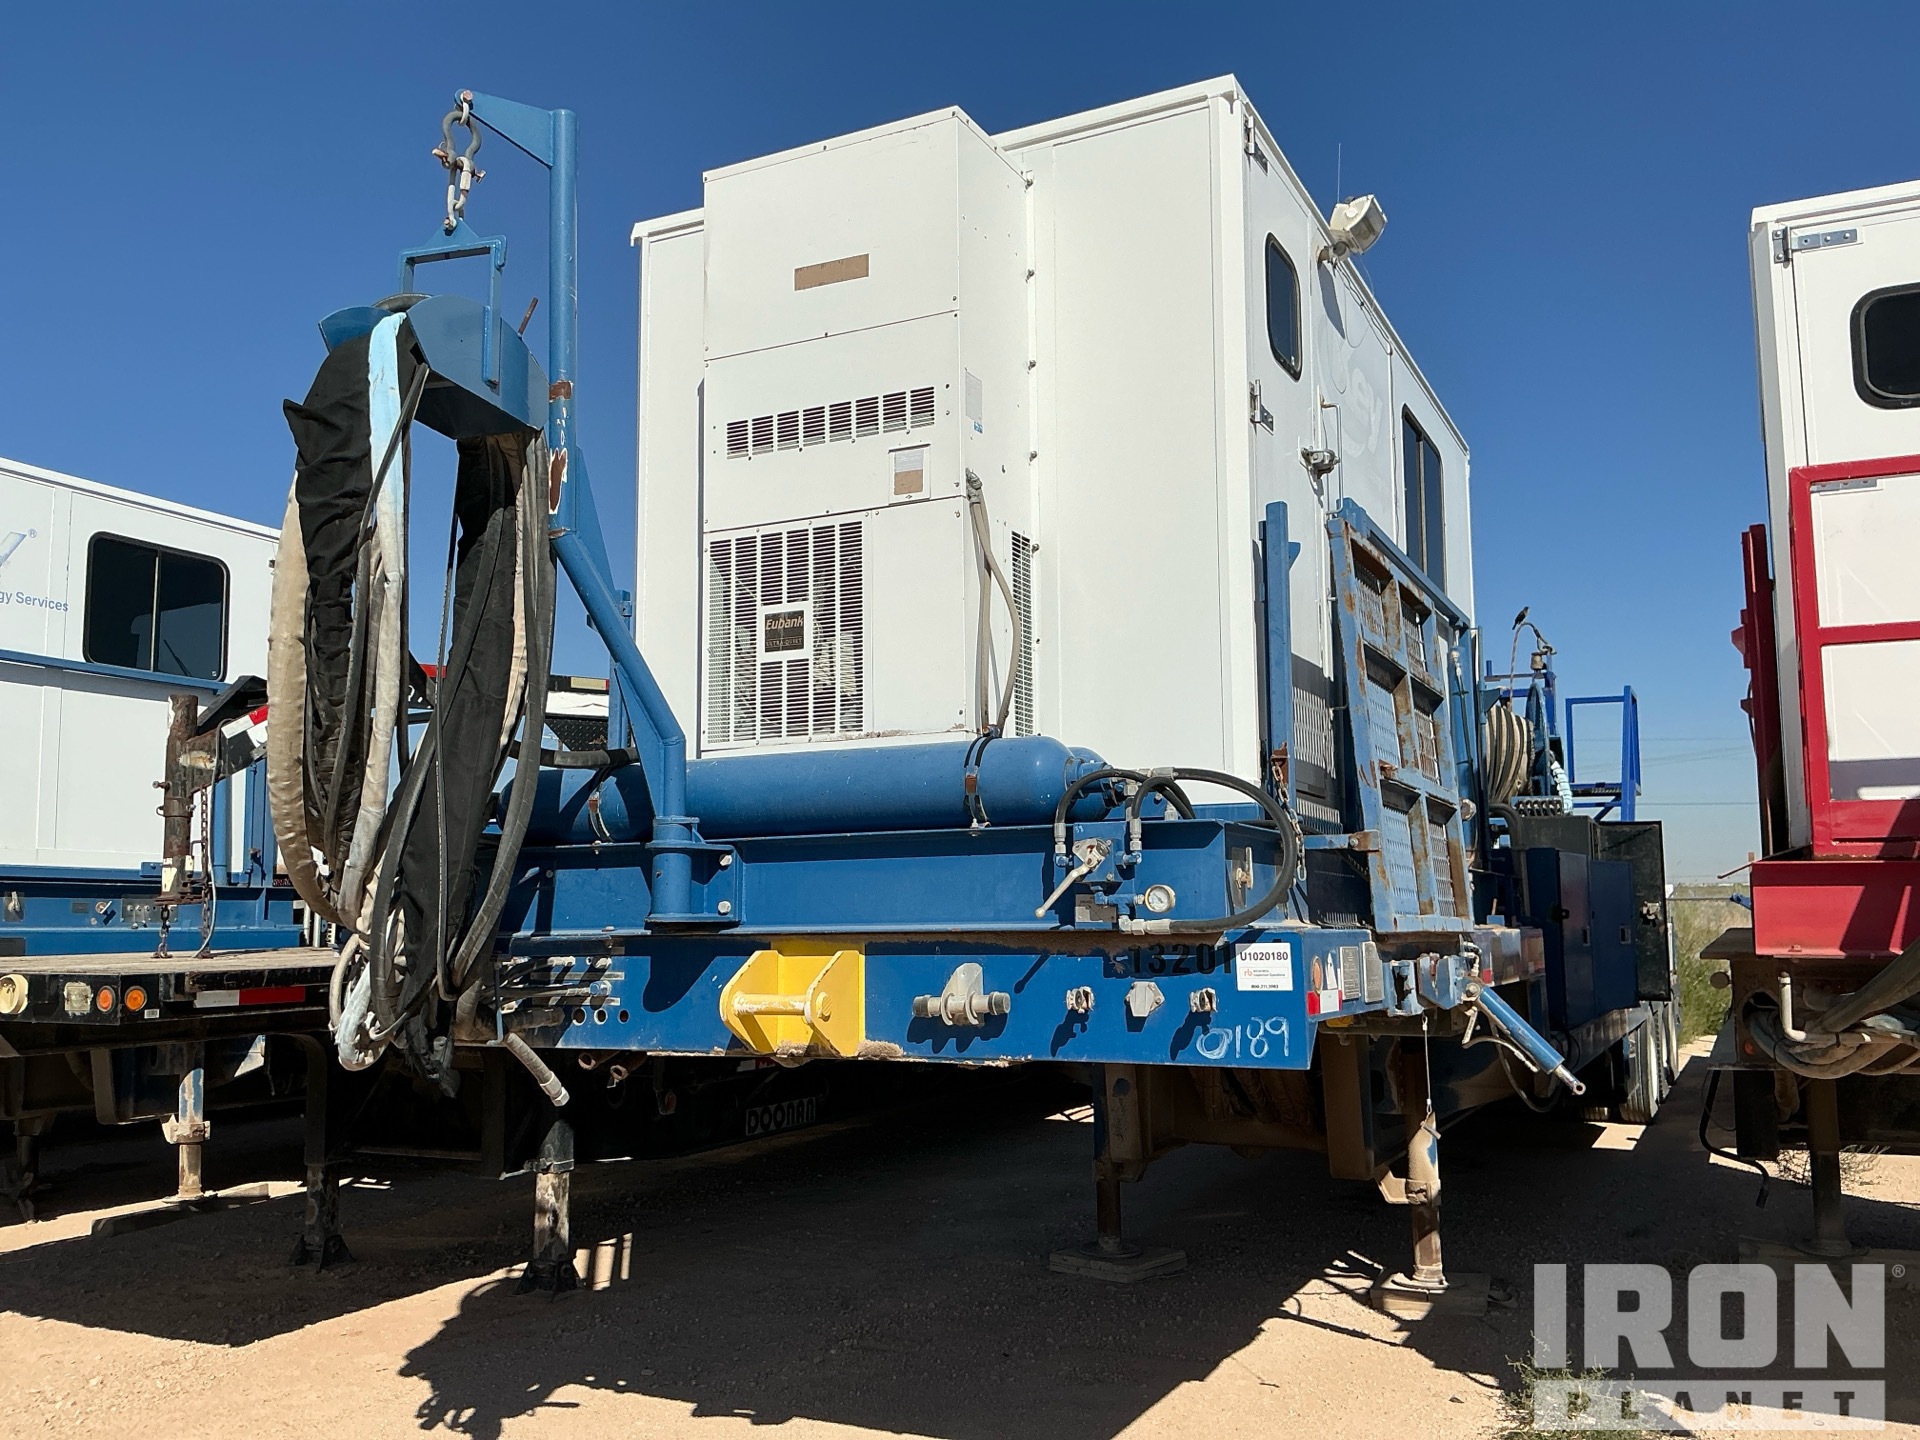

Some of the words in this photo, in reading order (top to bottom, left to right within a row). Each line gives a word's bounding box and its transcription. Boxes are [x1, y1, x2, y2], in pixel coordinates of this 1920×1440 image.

[16, 592, 69, 611] Services
[765, 616, 803, 630] Eubank
[1239, 951, 1289, 961] U1020180
[1196, 1015, 1290, 1060] 0189
[747, 1097, 816, 1135] DOONAN
